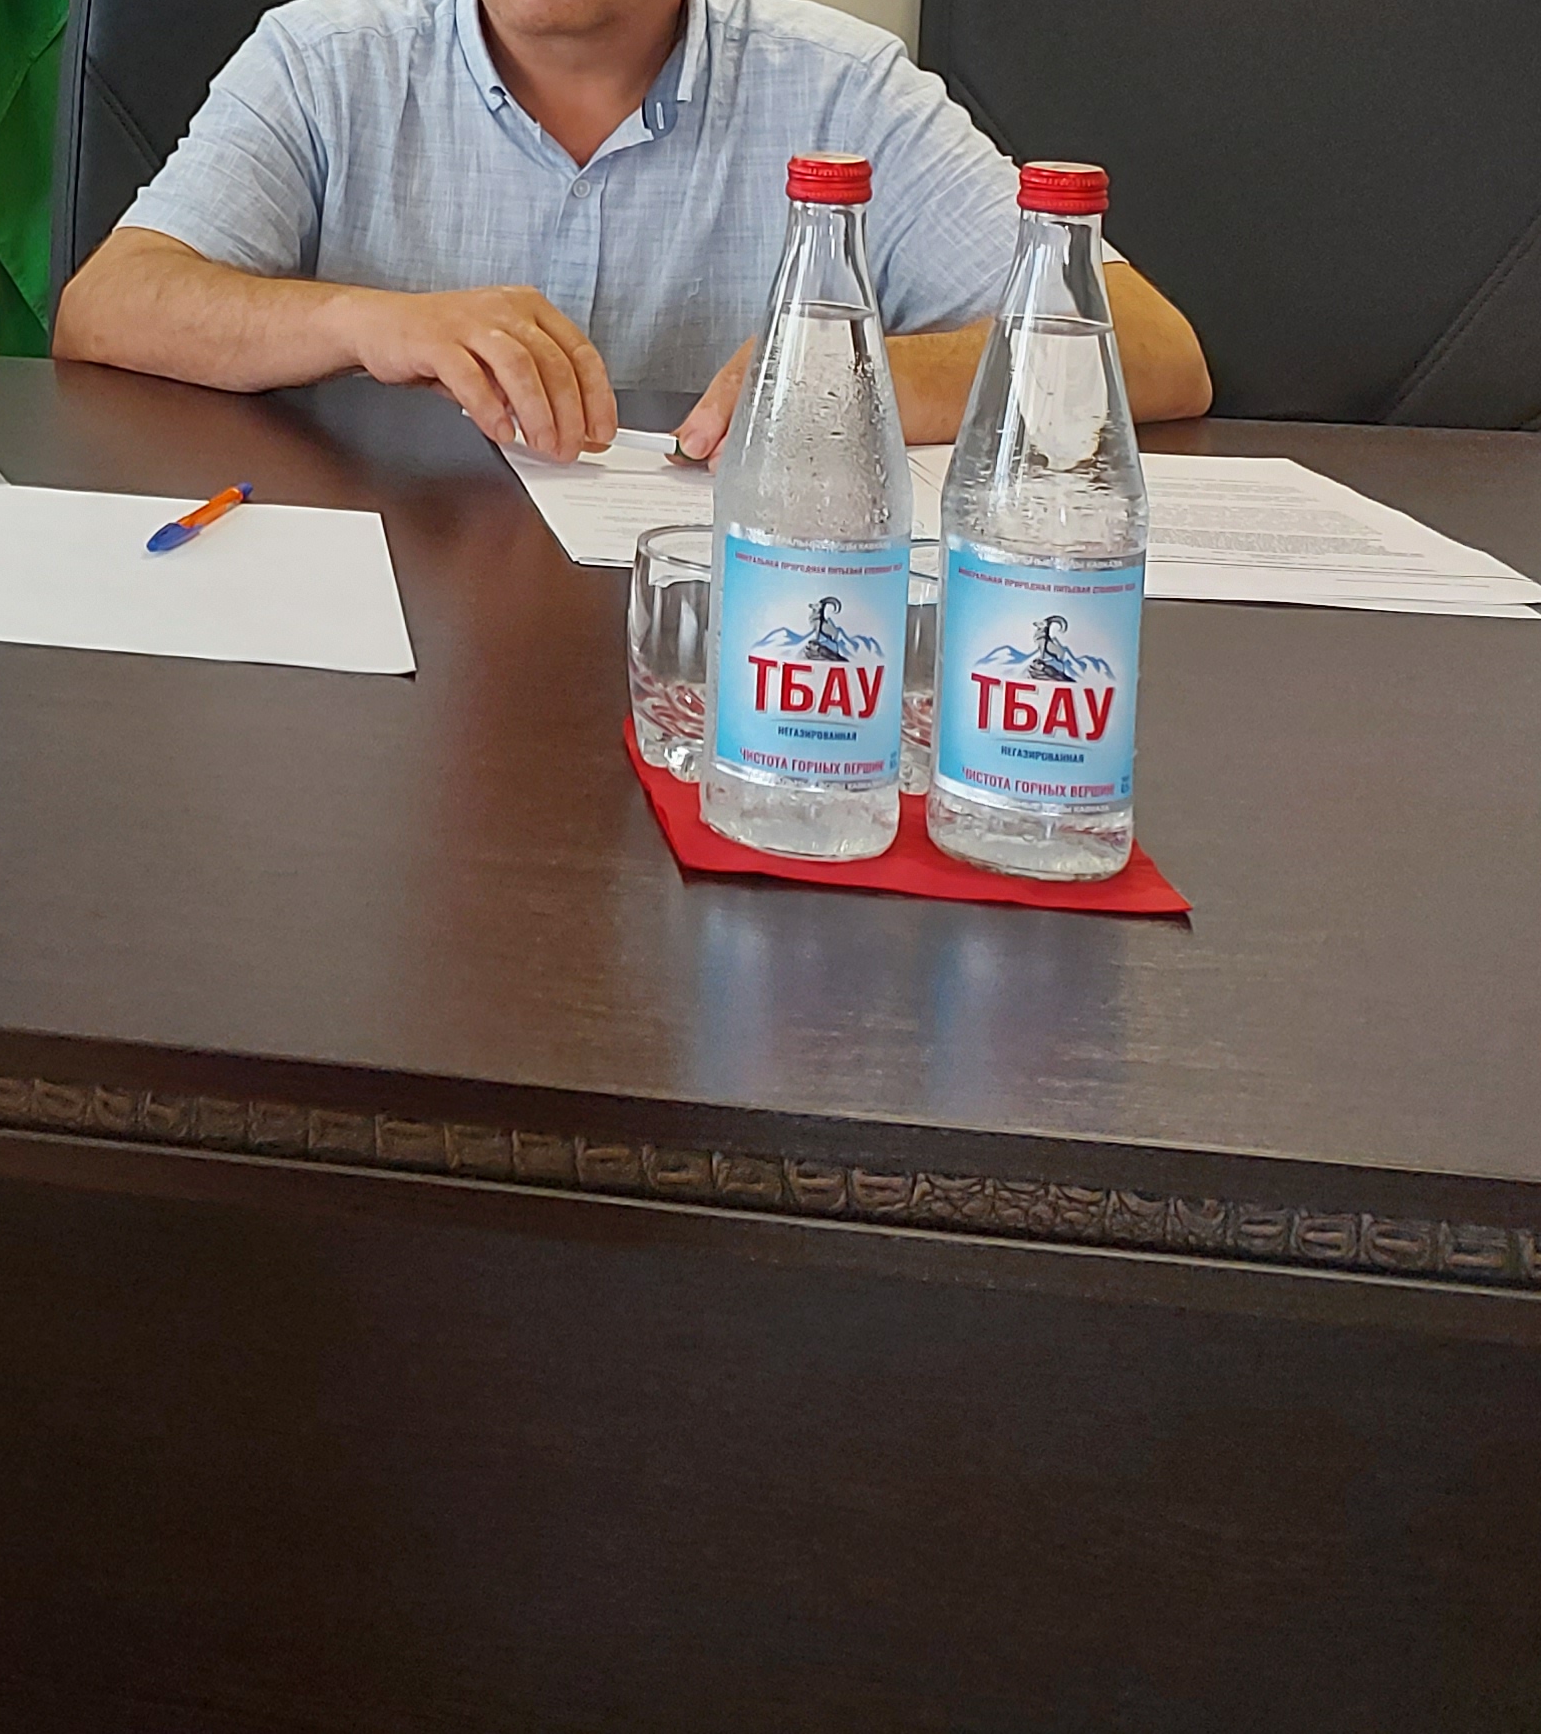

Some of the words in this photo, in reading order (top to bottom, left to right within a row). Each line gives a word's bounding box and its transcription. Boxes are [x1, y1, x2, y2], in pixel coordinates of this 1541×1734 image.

[748, 655, 884, 719] ТБАУ
[971, 672, 1115, 741] ТБАУ
[777, 726, 857, 741] НЕГАЗИРОВАННАЯ
[740, 747, 788, 770] ЧИСТОТА
[791, 758, 841, 775] ГОРНЫХ
[1000, 745, 1085, 763] НЕГАЗИРОВАННАЯ
[962, 766, 1011, 791] ЧИСТОТА
[1015, 779, 1066, 797] ГОРНЫХ
